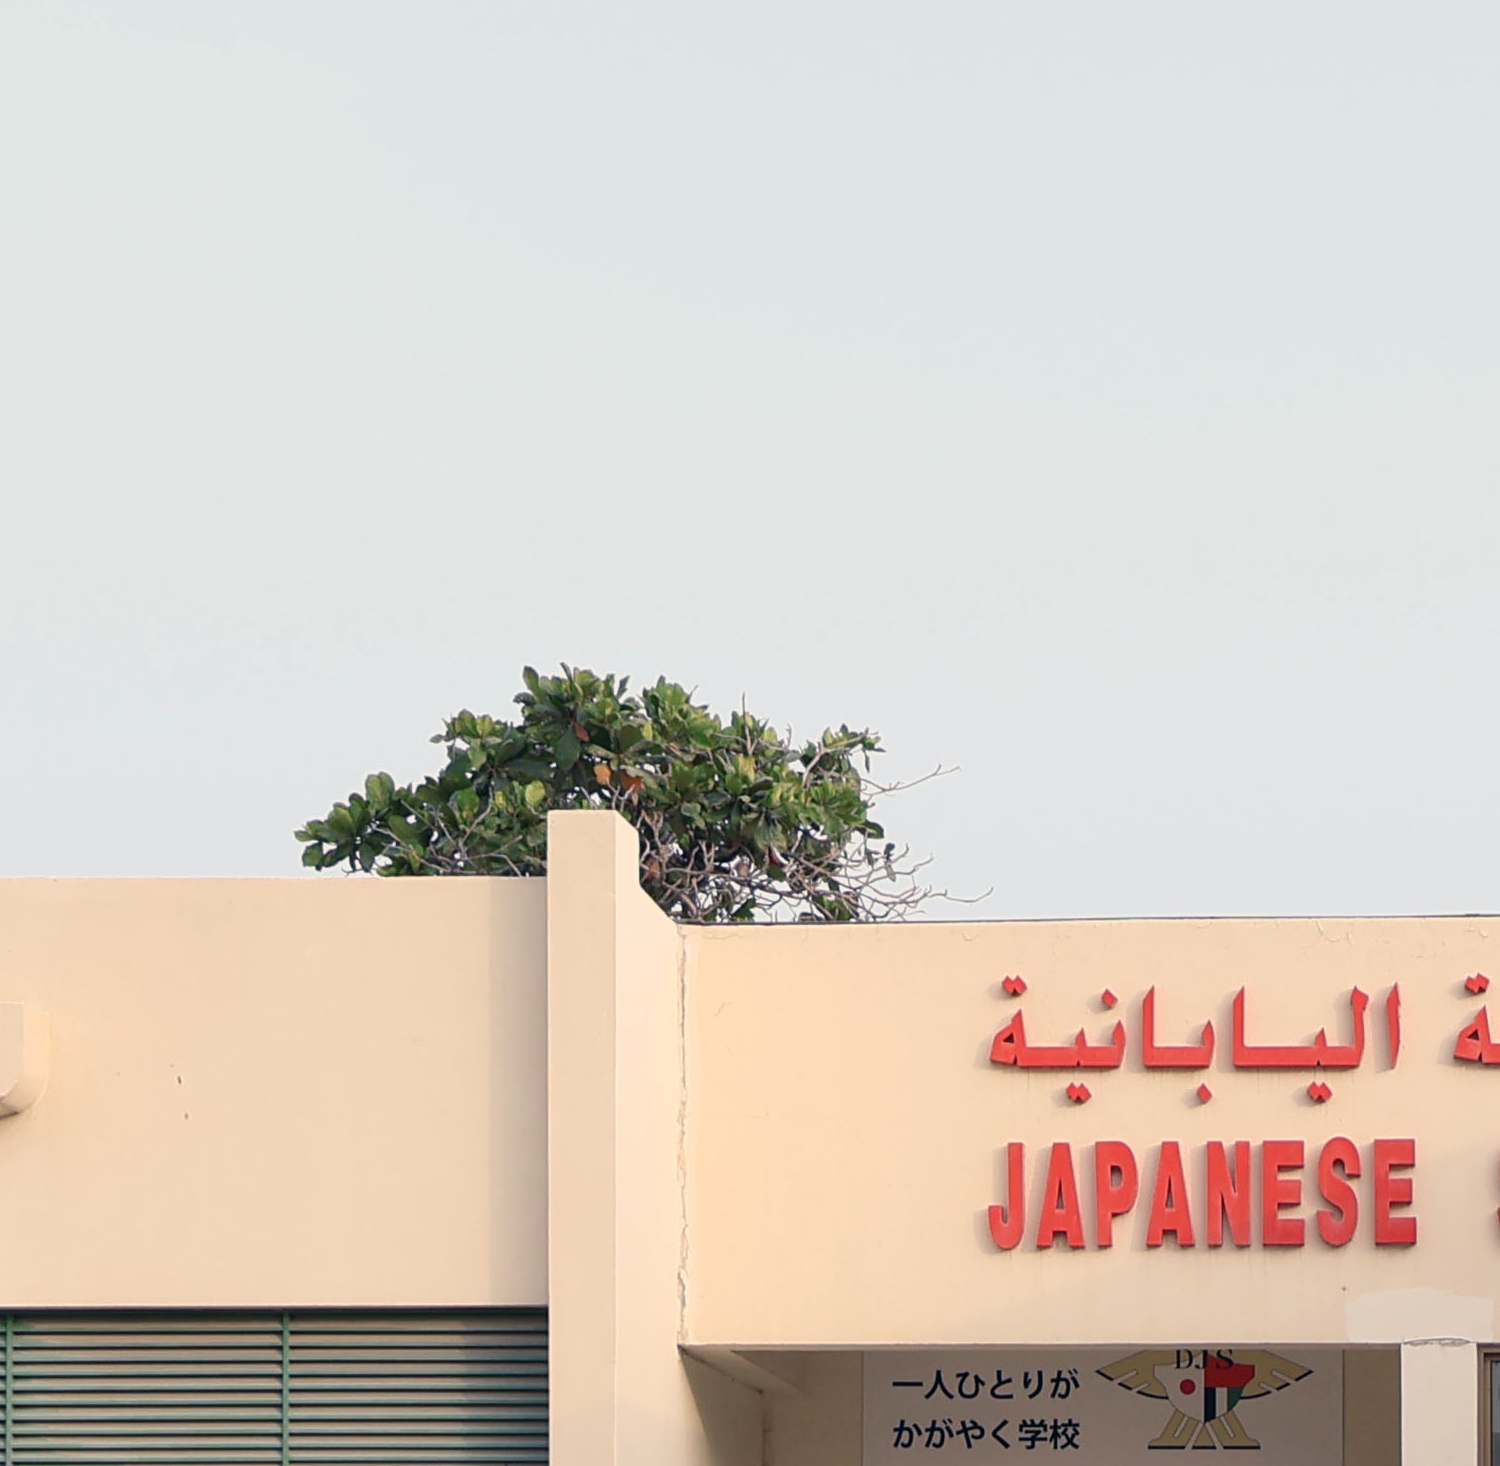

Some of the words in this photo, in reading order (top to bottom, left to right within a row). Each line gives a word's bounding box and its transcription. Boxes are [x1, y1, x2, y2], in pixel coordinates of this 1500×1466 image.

[988, 974, 1402, 1104] اليابانية
[987, 1137, 1418, 1250] JAPANESE
[1174, 1348, 1235, 1370] DJS
[892, 1368, 1081, 1400] 一人ひとりが
[892, 1417, 1081, 1450] かがやく学校
